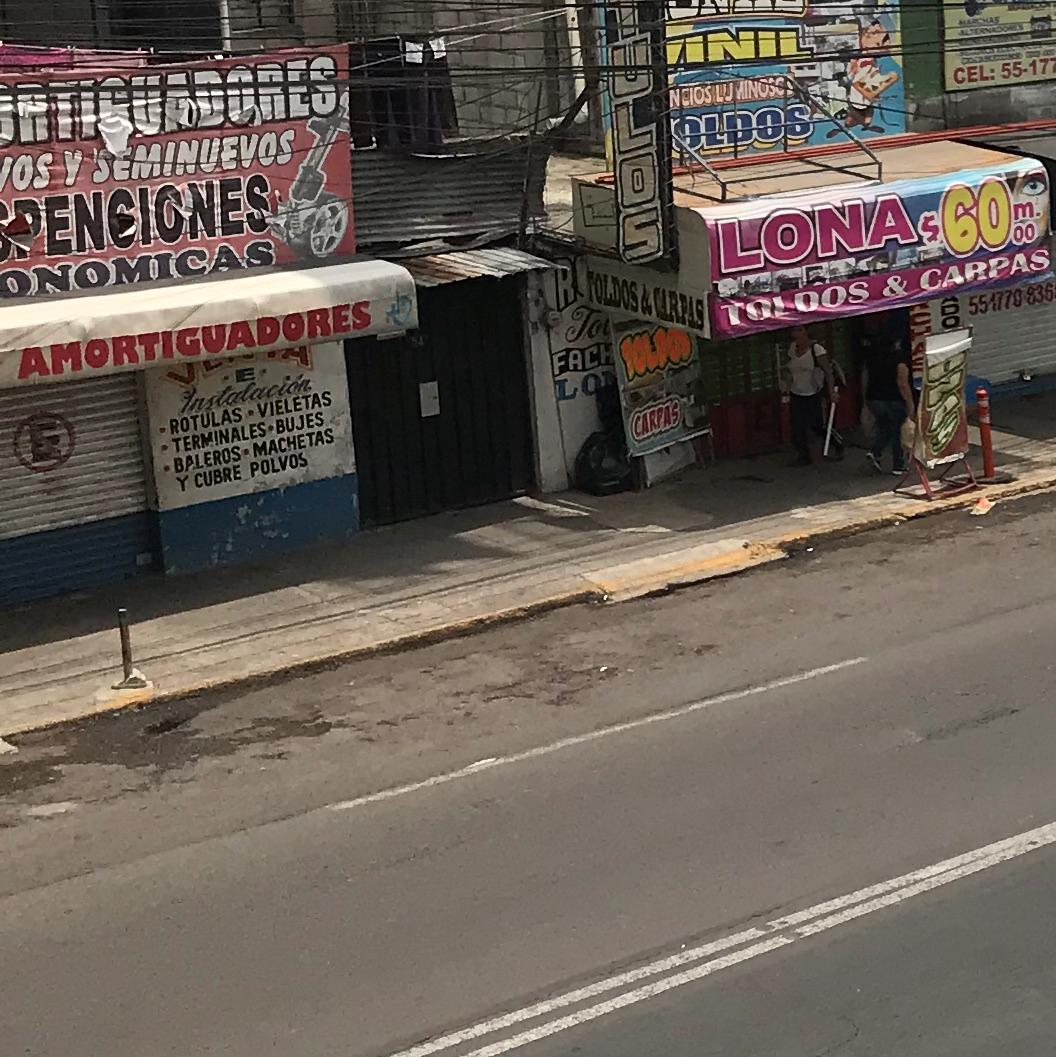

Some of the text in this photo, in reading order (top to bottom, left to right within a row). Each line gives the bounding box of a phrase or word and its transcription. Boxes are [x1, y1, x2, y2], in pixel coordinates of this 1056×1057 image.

[953, 64, 995, 85] CEL:
[64, 149, 83, 187] Y
[716, 194, 918, 274] LONA
[941, 176, 1013, 257] 60
[653, 287, 704, 330] CARPAS
[720, 280, 871, 327] TOLDOS
[882, 274, 908, 296] &
[919, 249, 1051, 289] CARPAS
[17, 300, 372, 380] AMORTIGUADORES
[169, 391, 333, 435] ROTULAS VIELETAS
[172, 411, 325, 453] TERMINALES BUJES
[633, 400, 681, 438] CARPAS
[173, 428, 335, 474] BALEROS MACHETAS
[175, 452, 309, 492] Y CUBRE POLVOS
